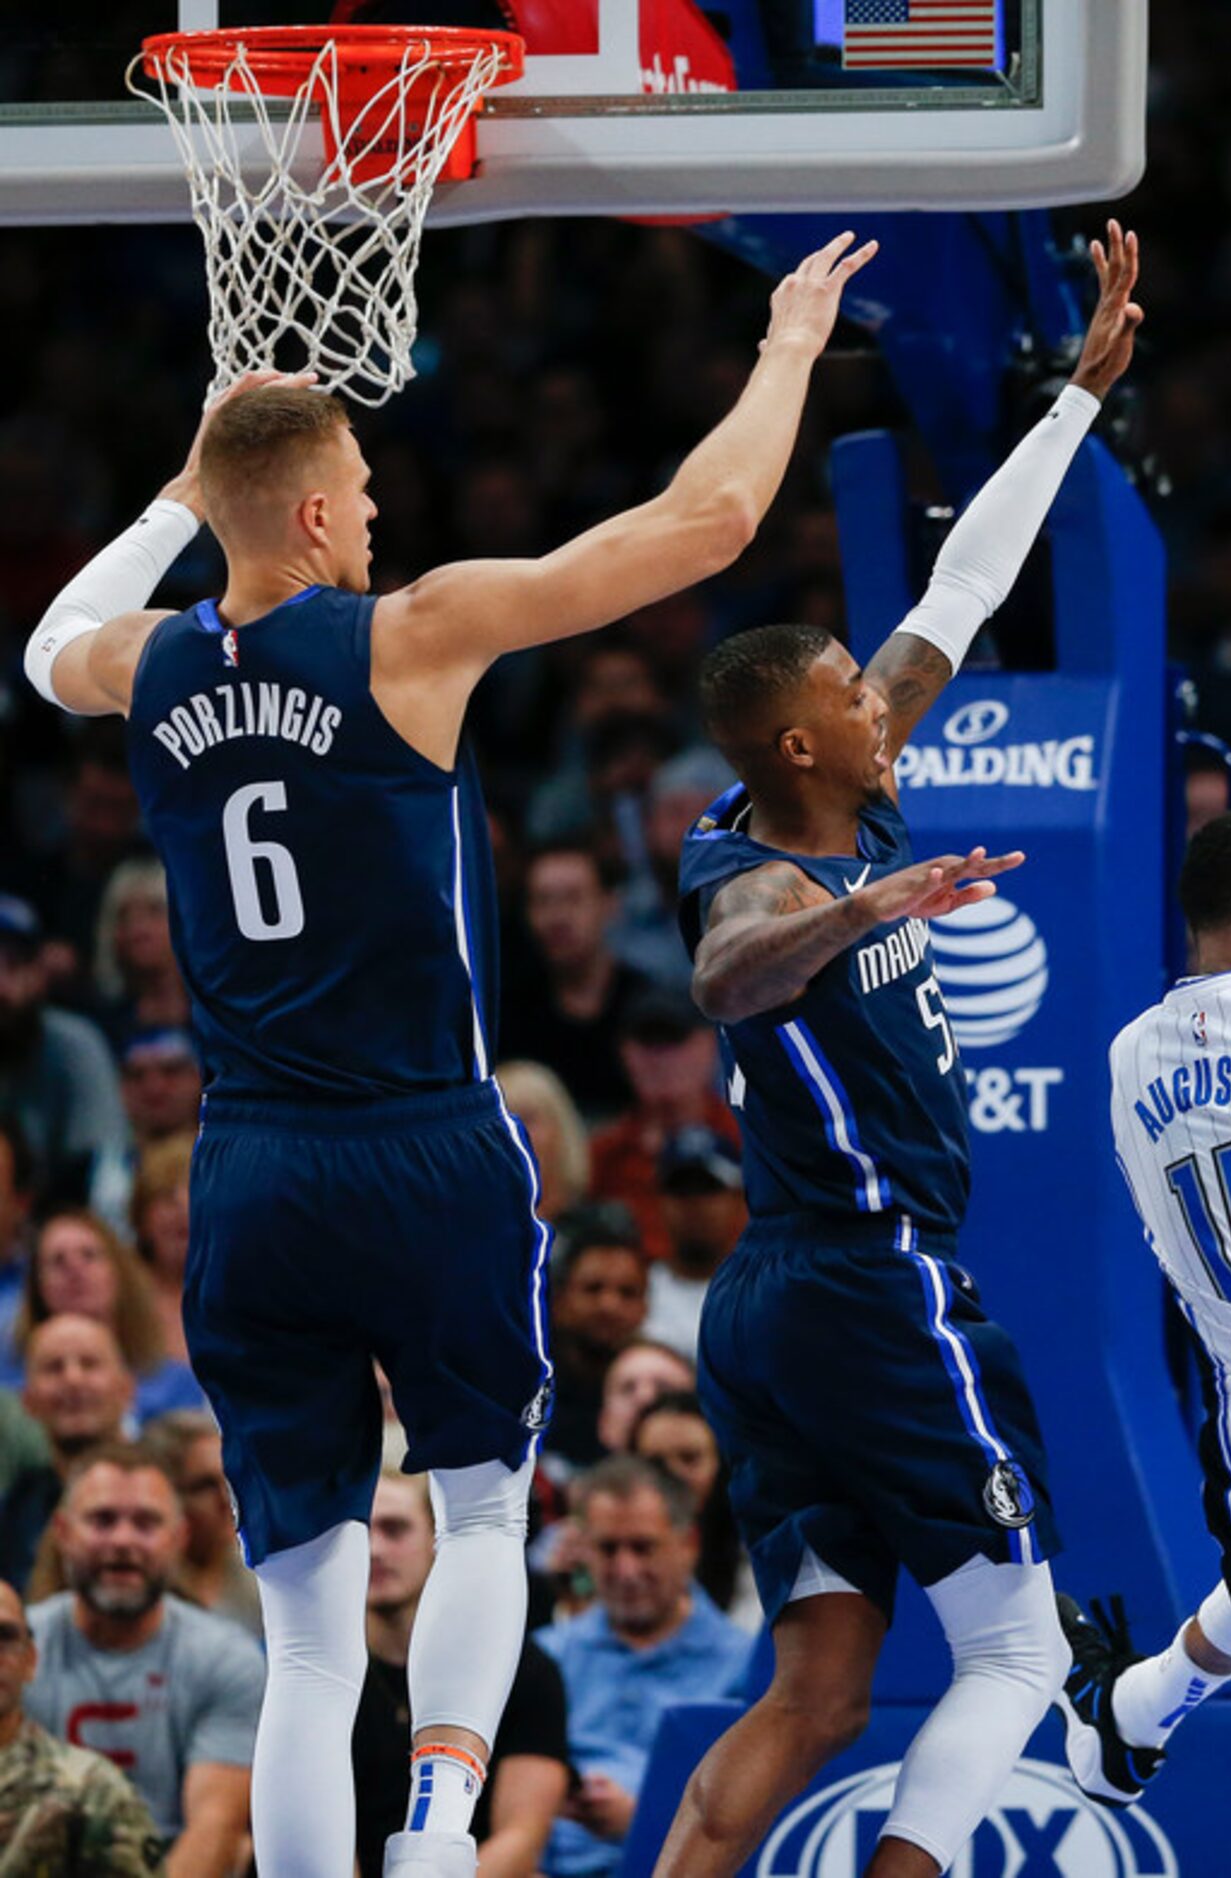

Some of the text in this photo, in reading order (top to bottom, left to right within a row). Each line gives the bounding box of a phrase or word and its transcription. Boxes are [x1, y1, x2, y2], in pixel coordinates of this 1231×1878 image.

[153, 682, 342, 770] PORZINGIS
[893, 736, 1096, 791] PALDING
[222, 781, 305, 942] 6
